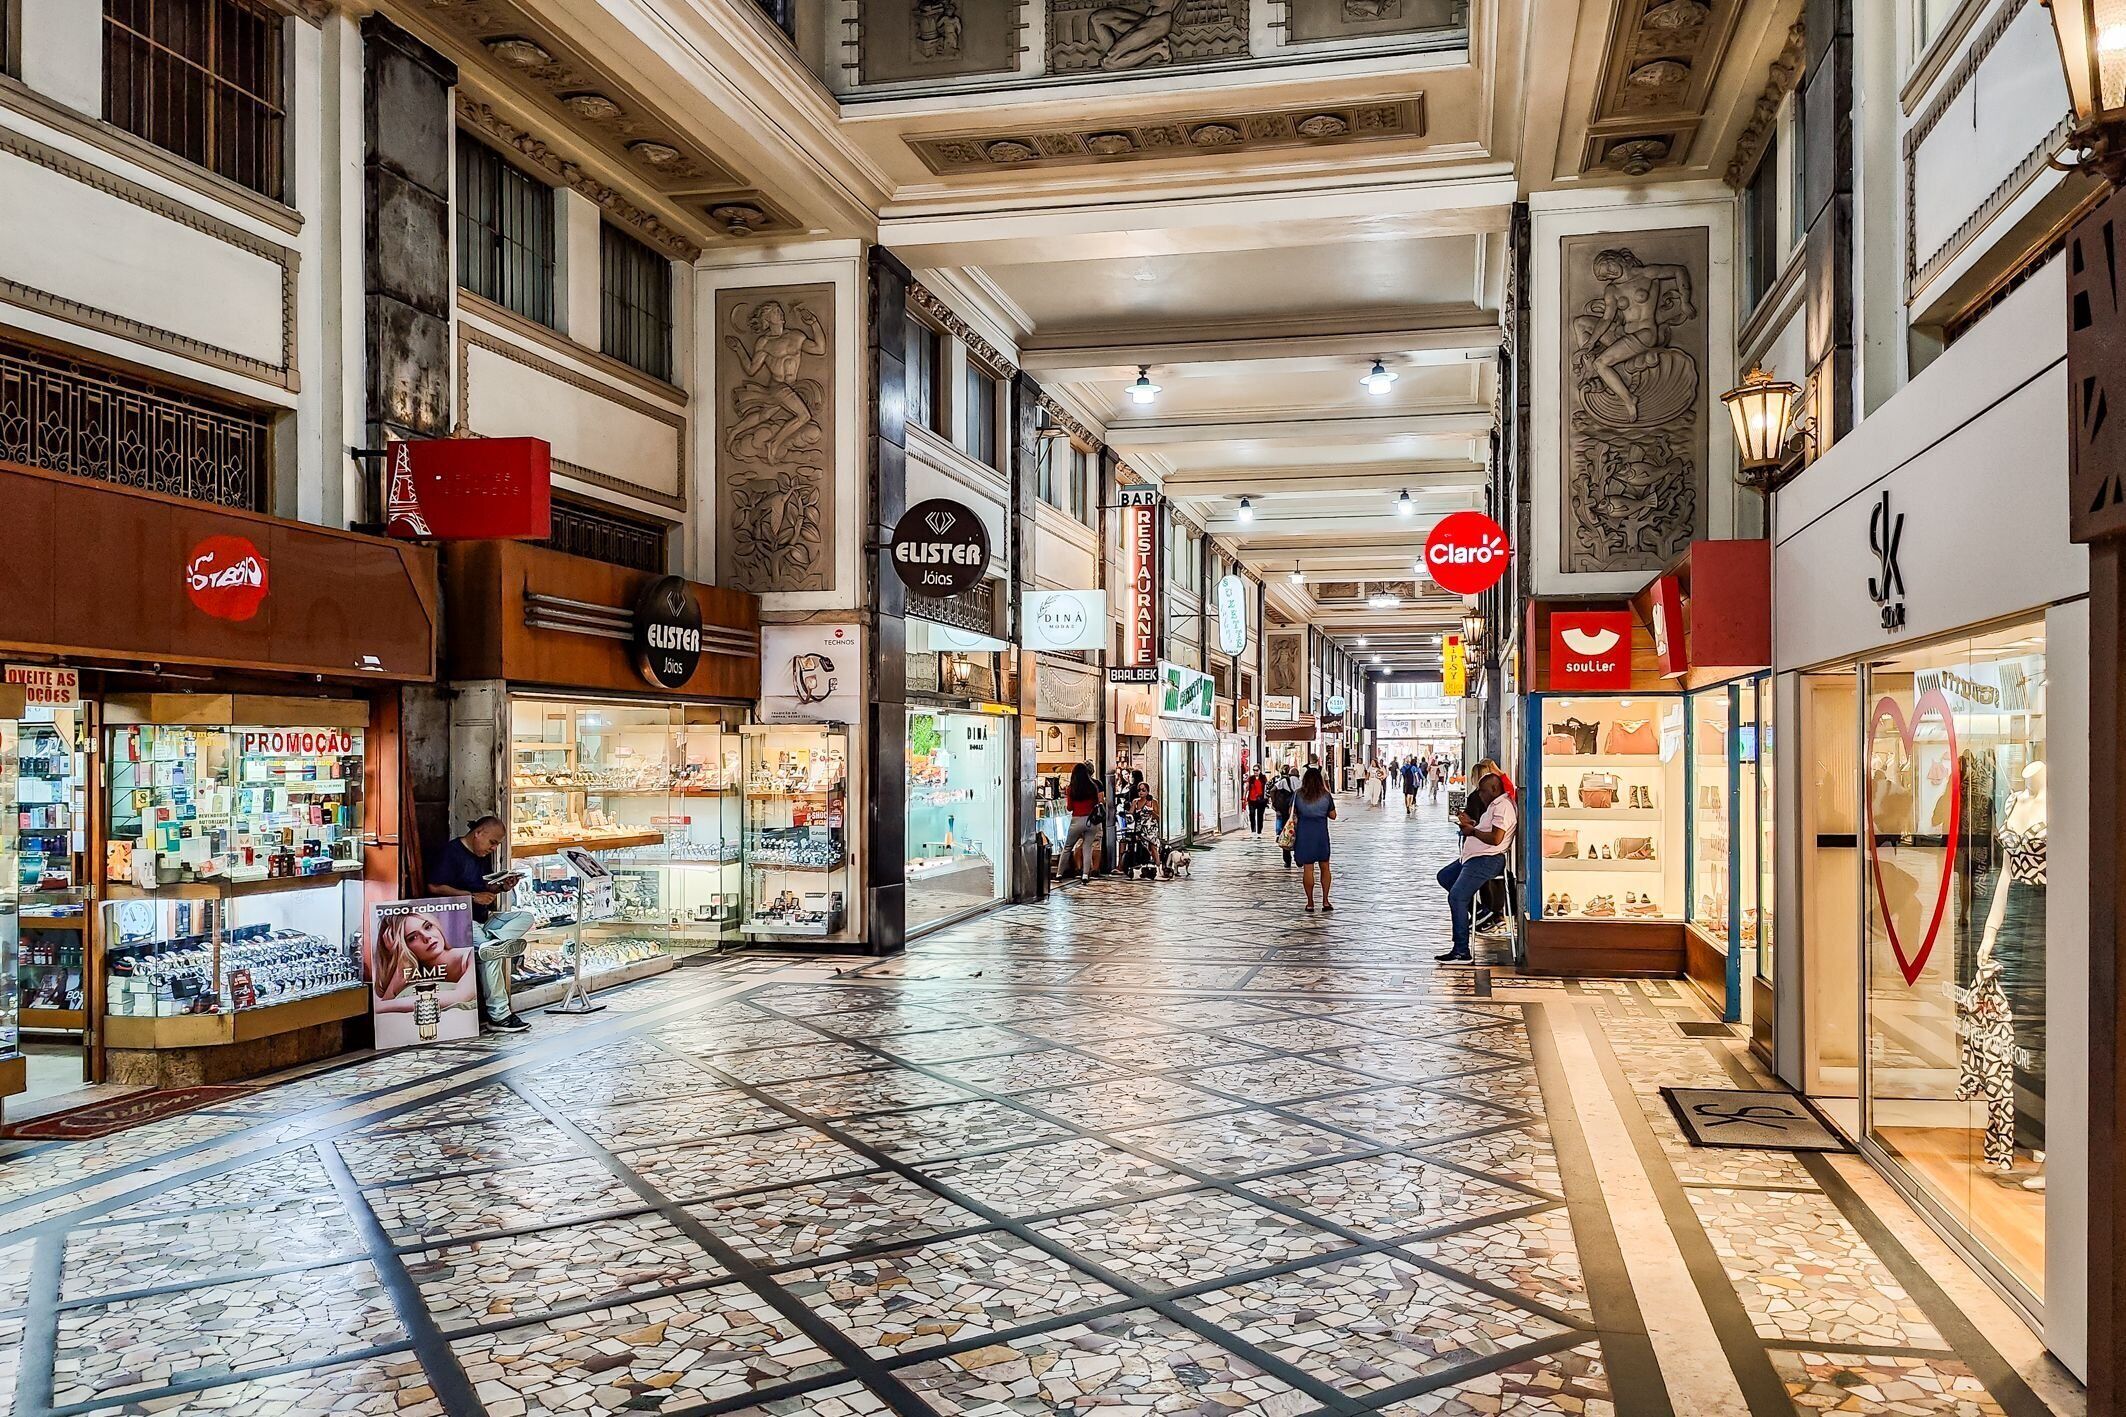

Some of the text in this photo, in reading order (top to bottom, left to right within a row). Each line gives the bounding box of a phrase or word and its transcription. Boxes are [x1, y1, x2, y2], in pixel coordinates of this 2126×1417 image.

[1121, 493, 1154, 505] BAR
[895, 541, 981, 565] ELISTER
[1429, 543, 1493, 565] Claro
[921, 570, 953, 585] Jóias
[1137, 510, 1152, 662] RESTAURANTE
[1044, 610, 1082, 623] DINÁ
[647, 623, 700, 652] ELISTER
[663, 656, 683, 675] Jóias
[1565, 660, 1616, 672] soulier
[56, 672, 76, 687] AS
[1111, 668, 1158, 681] BAALBEK
[27, 685, 71, 705] OÇÕES
[966, 724, 988, 741] DINÁ
[244, 728, 353, 758] PROMOÇÃO
[411, 902, 468, 915] rabanne
[402, 964, 448, 980] FAME
